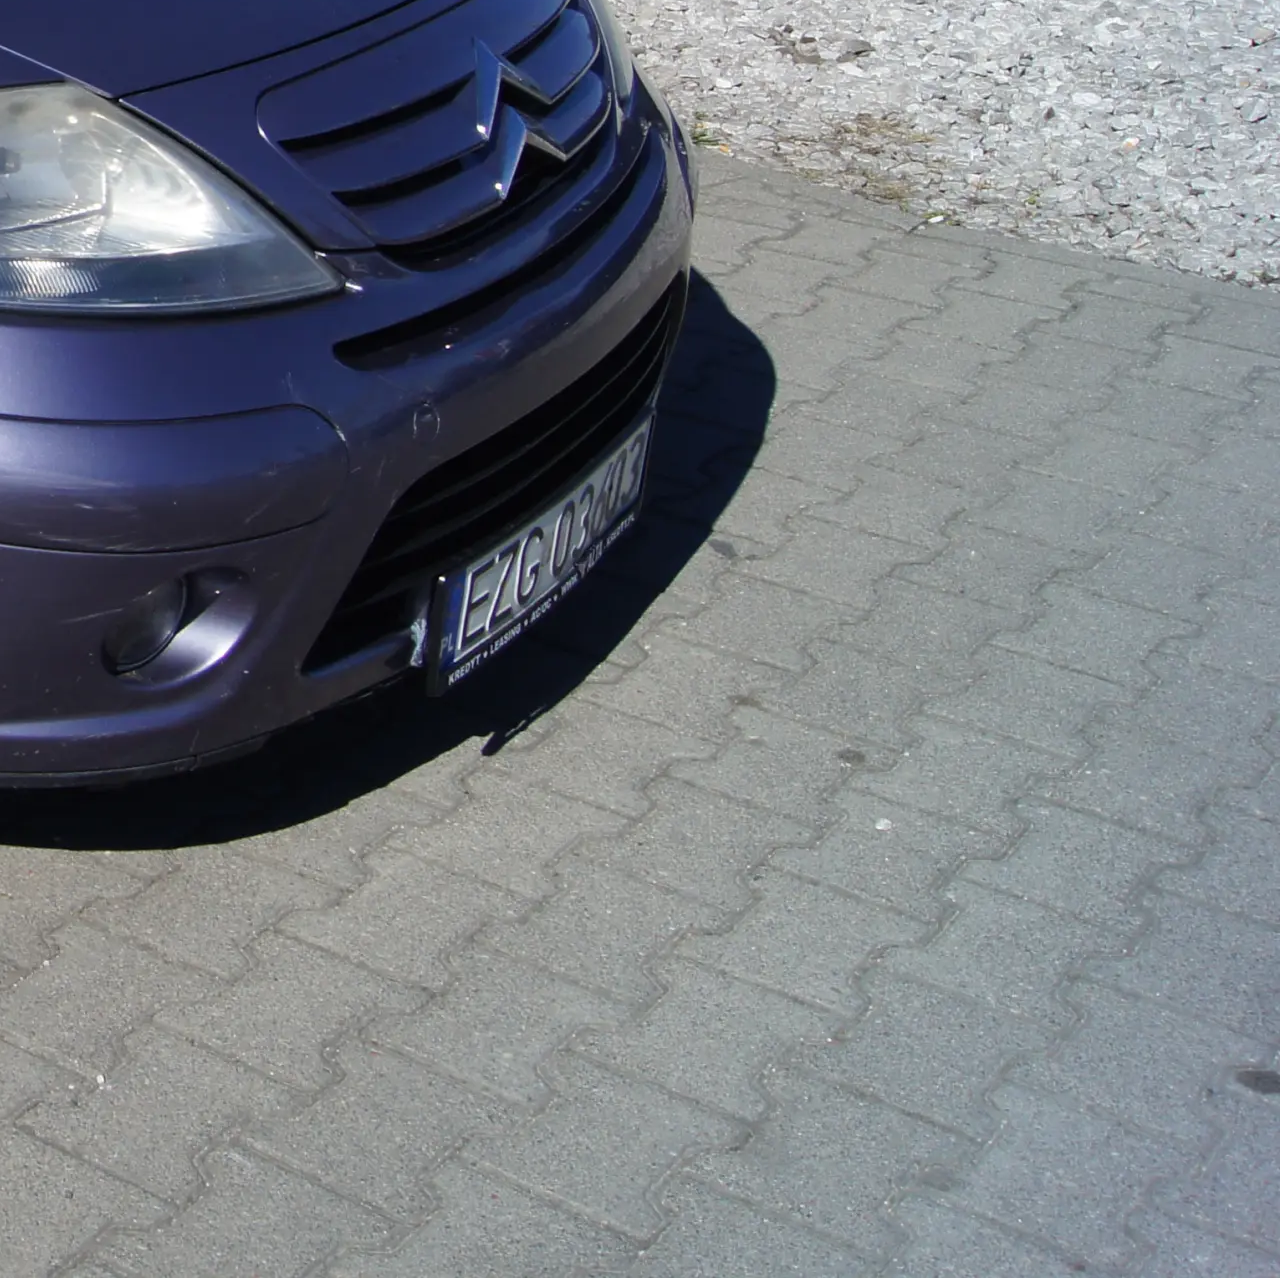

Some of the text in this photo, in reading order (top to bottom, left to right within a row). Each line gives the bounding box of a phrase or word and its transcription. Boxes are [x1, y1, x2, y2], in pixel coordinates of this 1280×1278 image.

[456, 526, 545, 652] EZG
[447, 654, 482, 686] KREDYT
[488, 620, 523, 657] LEASING
